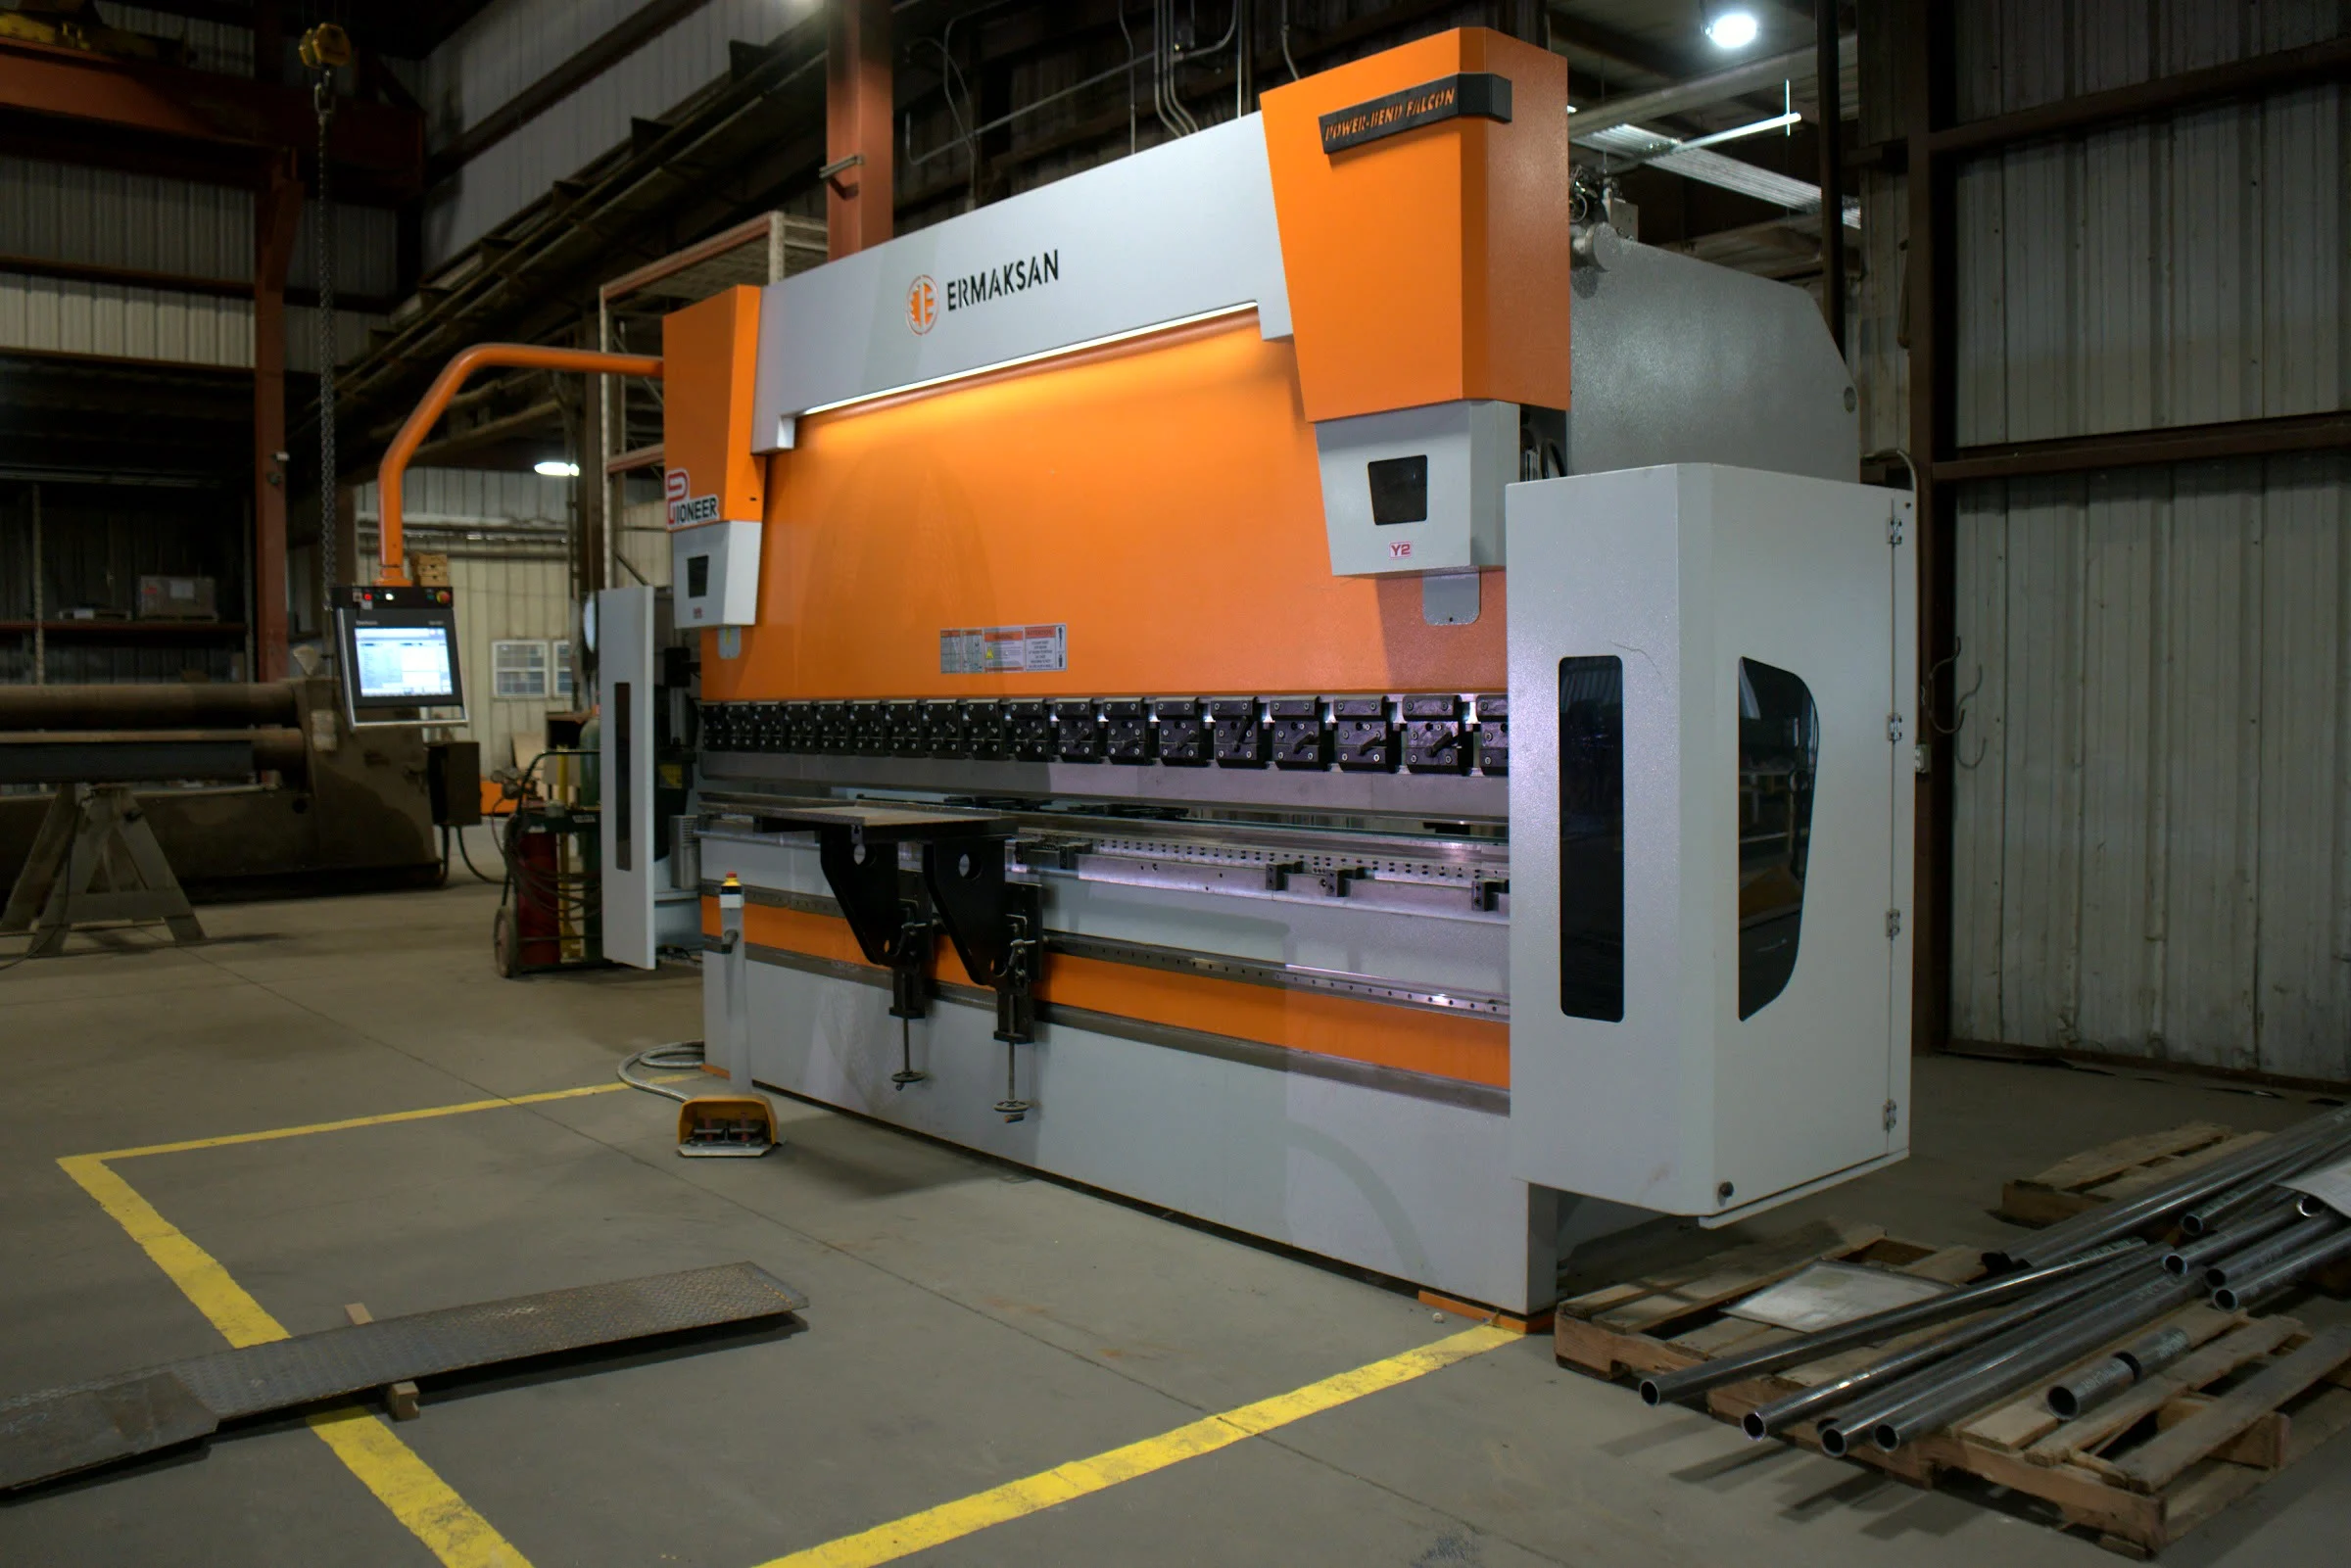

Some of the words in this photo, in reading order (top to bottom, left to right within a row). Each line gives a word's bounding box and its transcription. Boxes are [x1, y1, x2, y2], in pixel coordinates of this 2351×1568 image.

[1406, 87, 1456, 118] FALCON
[947, 249, 1059, 311] ERMAKSAN
[667, 471, 718, 525] PIONEER
[1391, 544, 1411, 556] Y2
